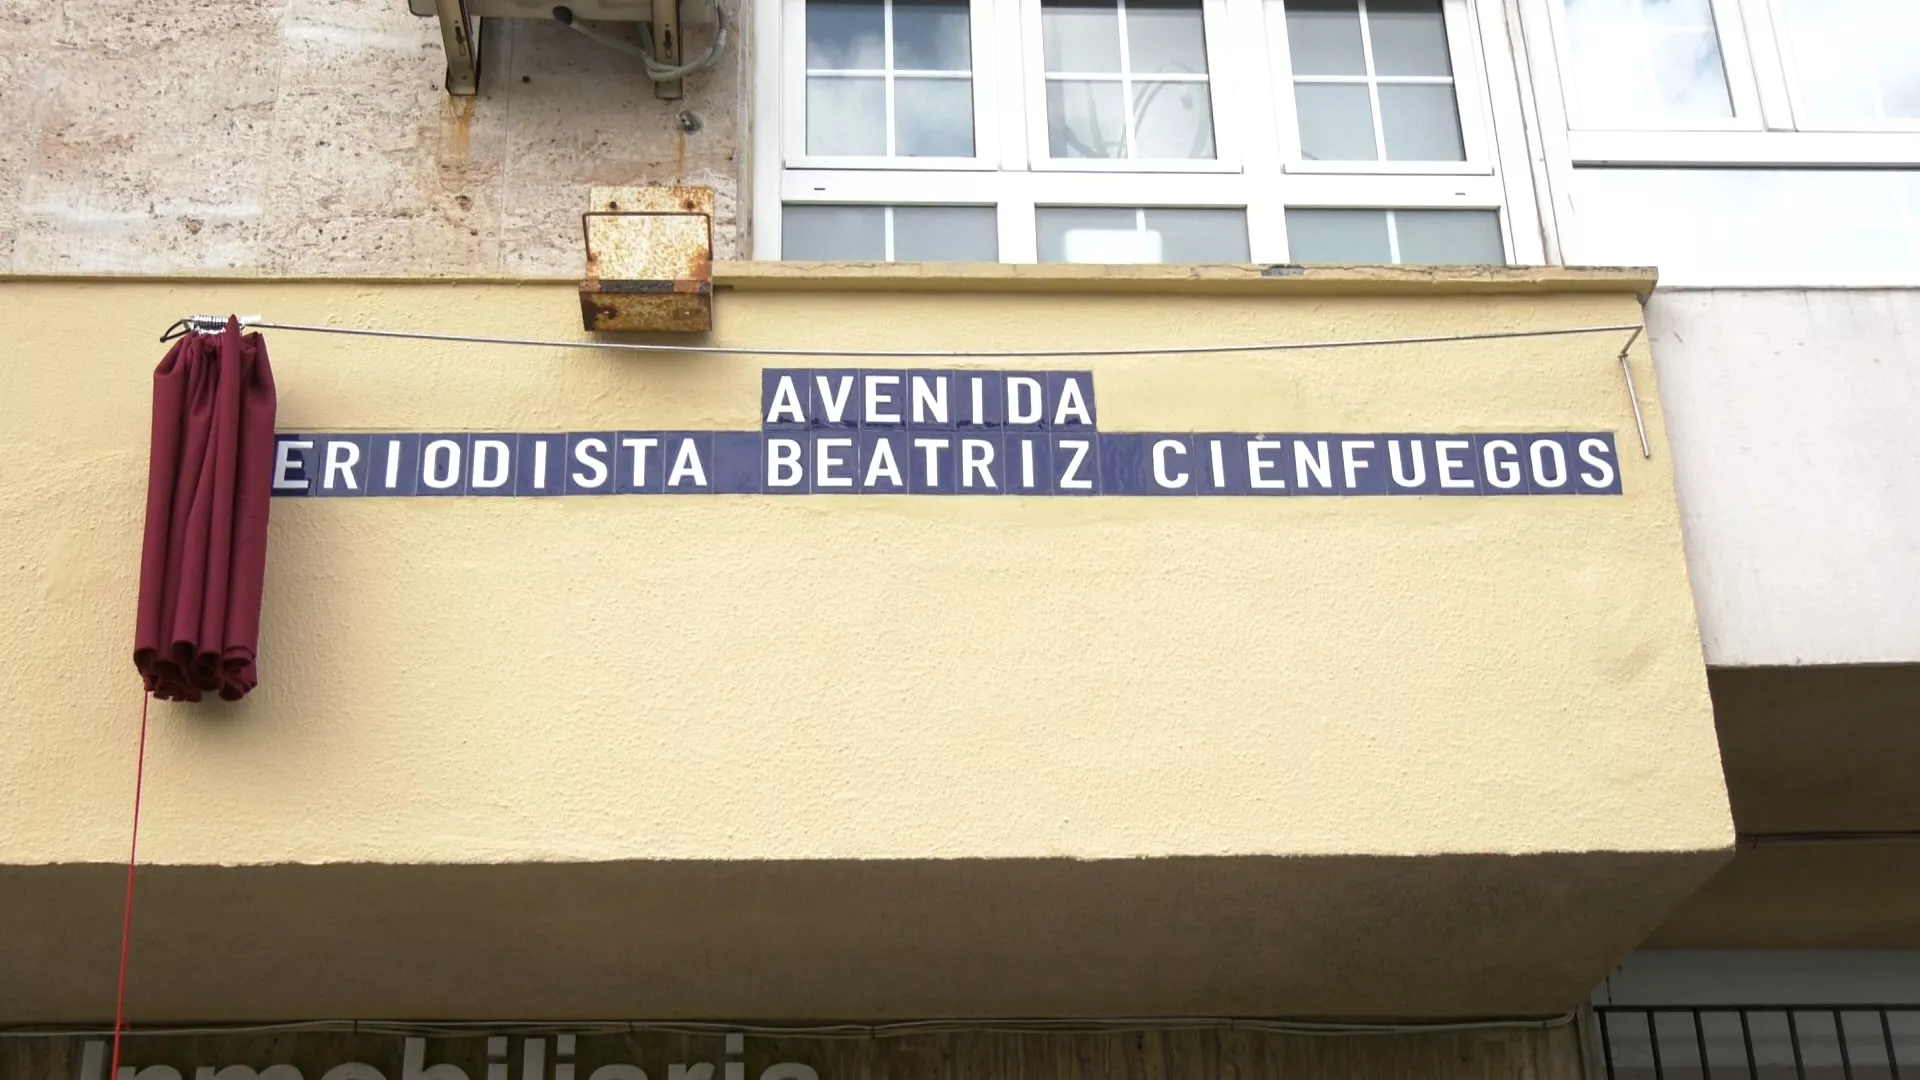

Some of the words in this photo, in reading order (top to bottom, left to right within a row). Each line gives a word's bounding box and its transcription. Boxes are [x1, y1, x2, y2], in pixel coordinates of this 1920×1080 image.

[766, 375, 1094, 425] AVENIDA
[272, 437, 709, 490] ERIODISTA
[766, 437, 1094, 490] BEATRIZ
[1151, 437, 1616, 490] CIENFUEGOS
